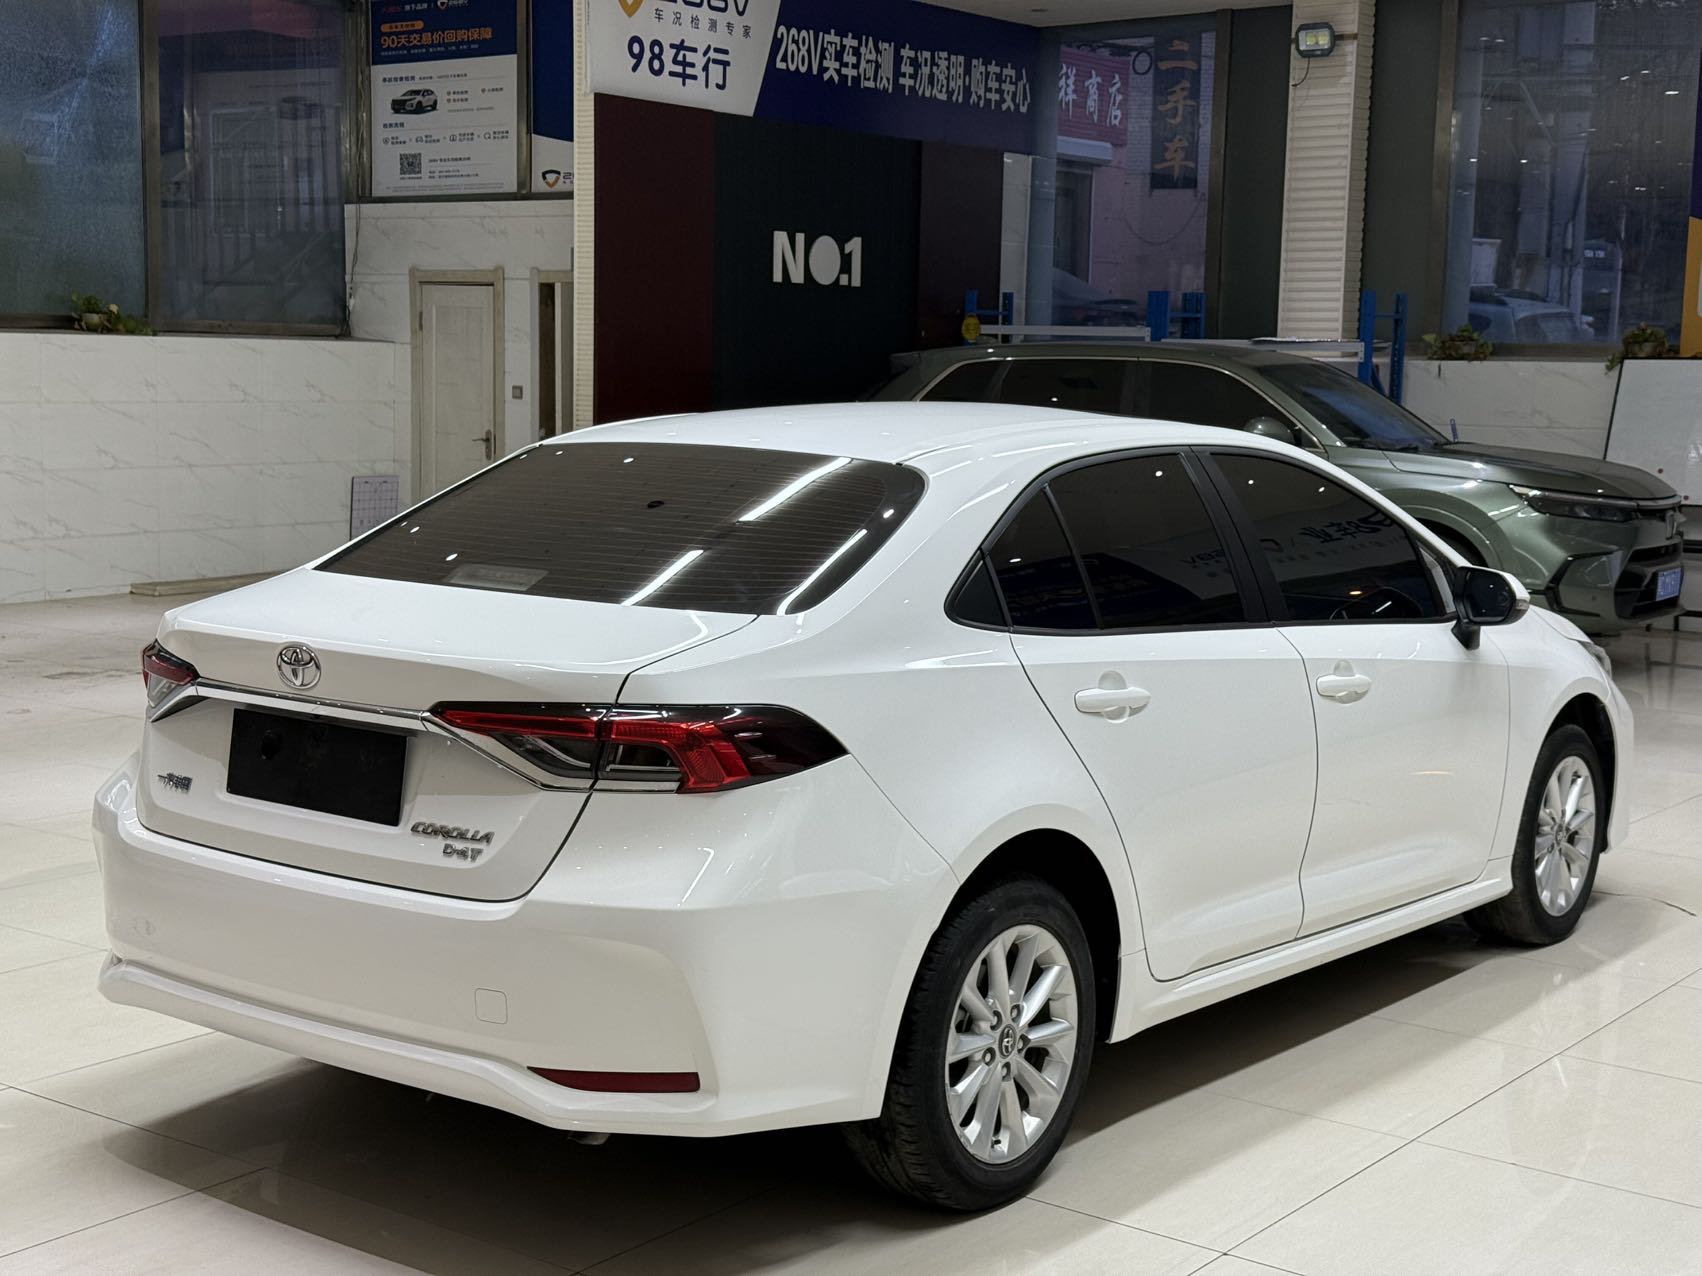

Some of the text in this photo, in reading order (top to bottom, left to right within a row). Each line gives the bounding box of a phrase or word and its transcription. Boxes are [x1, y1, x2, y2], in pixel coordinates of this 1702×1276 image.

[380, 27, 493, 48] 90天交易价回购保障
[654, 8, 752, 39] 车况检测专家
[628, 35, 731, 91] 98车行
[775, 25, 893, 93] 268V实车检测
[1153, 39, 1200, 181] 二手车
[410, 822, 495, 846] COROLLA
